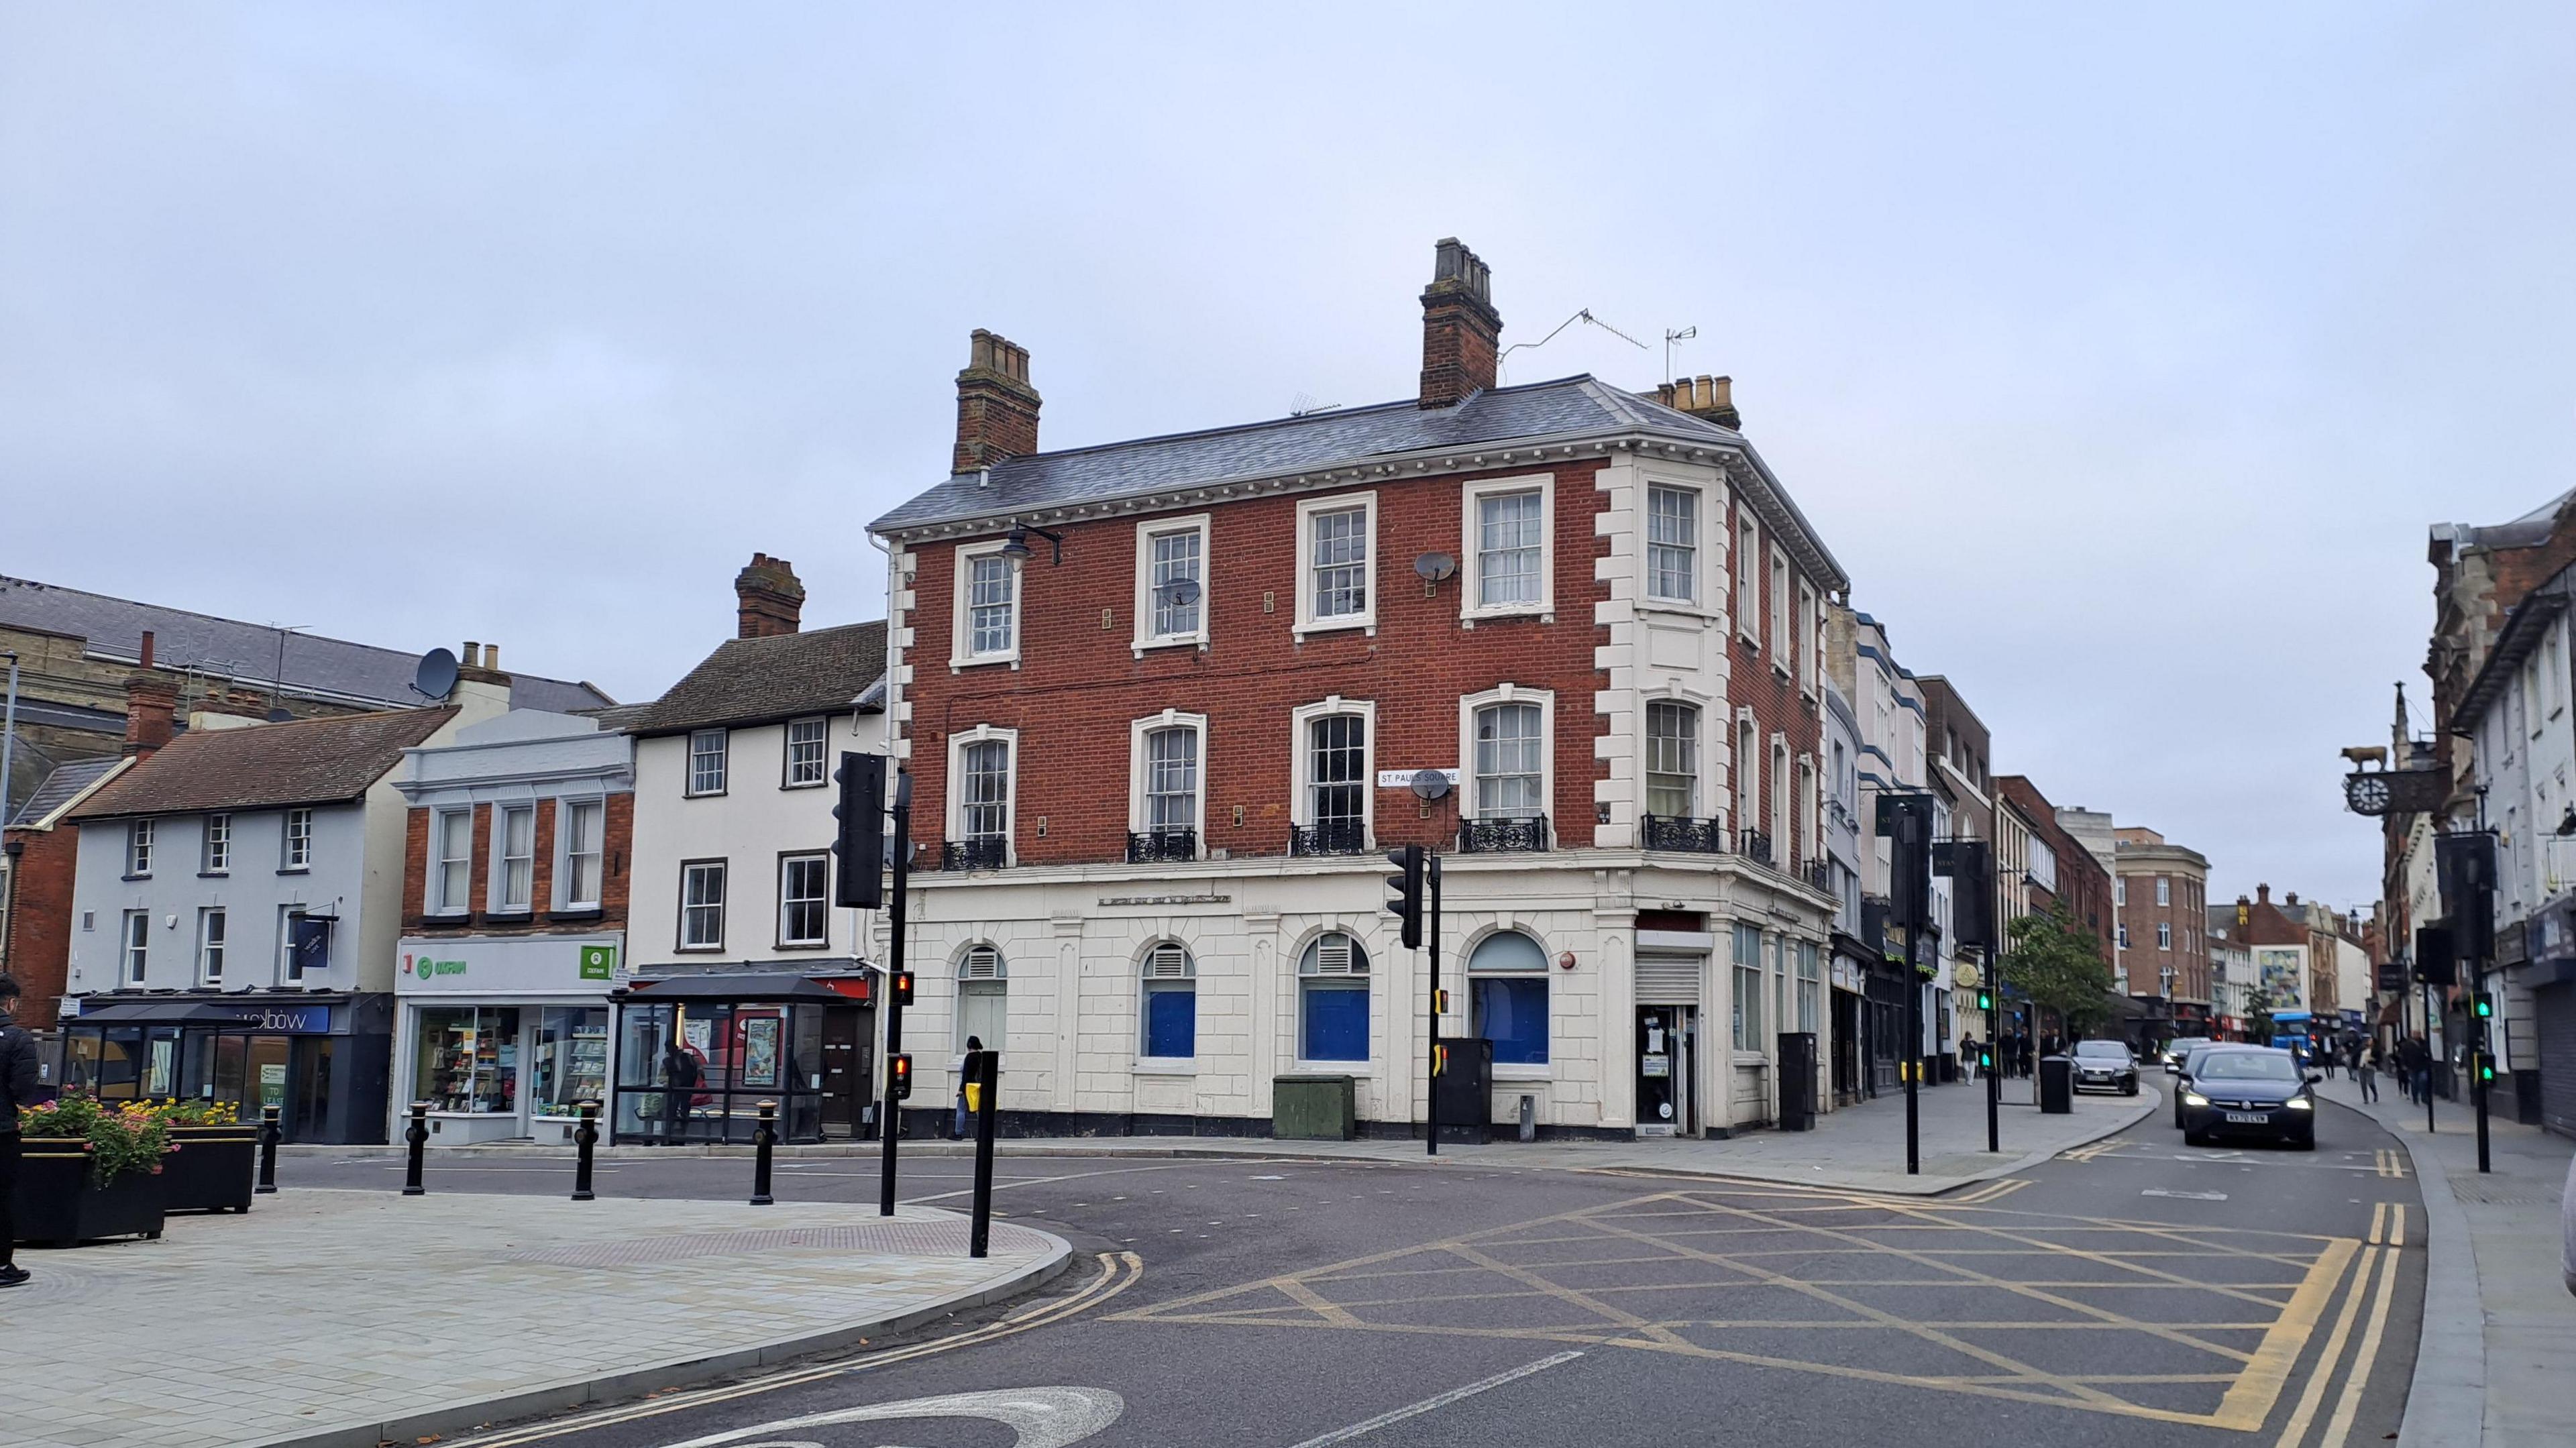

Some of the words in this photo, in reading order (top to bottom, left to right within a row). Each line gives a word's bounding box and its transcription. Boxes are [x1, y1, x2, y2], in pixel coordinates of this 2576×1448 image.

[1382, 774, 1393, 783] ST
[1424, 773, 1456, 781] SQUARE
[270, 1087, 279, 1096] TO
